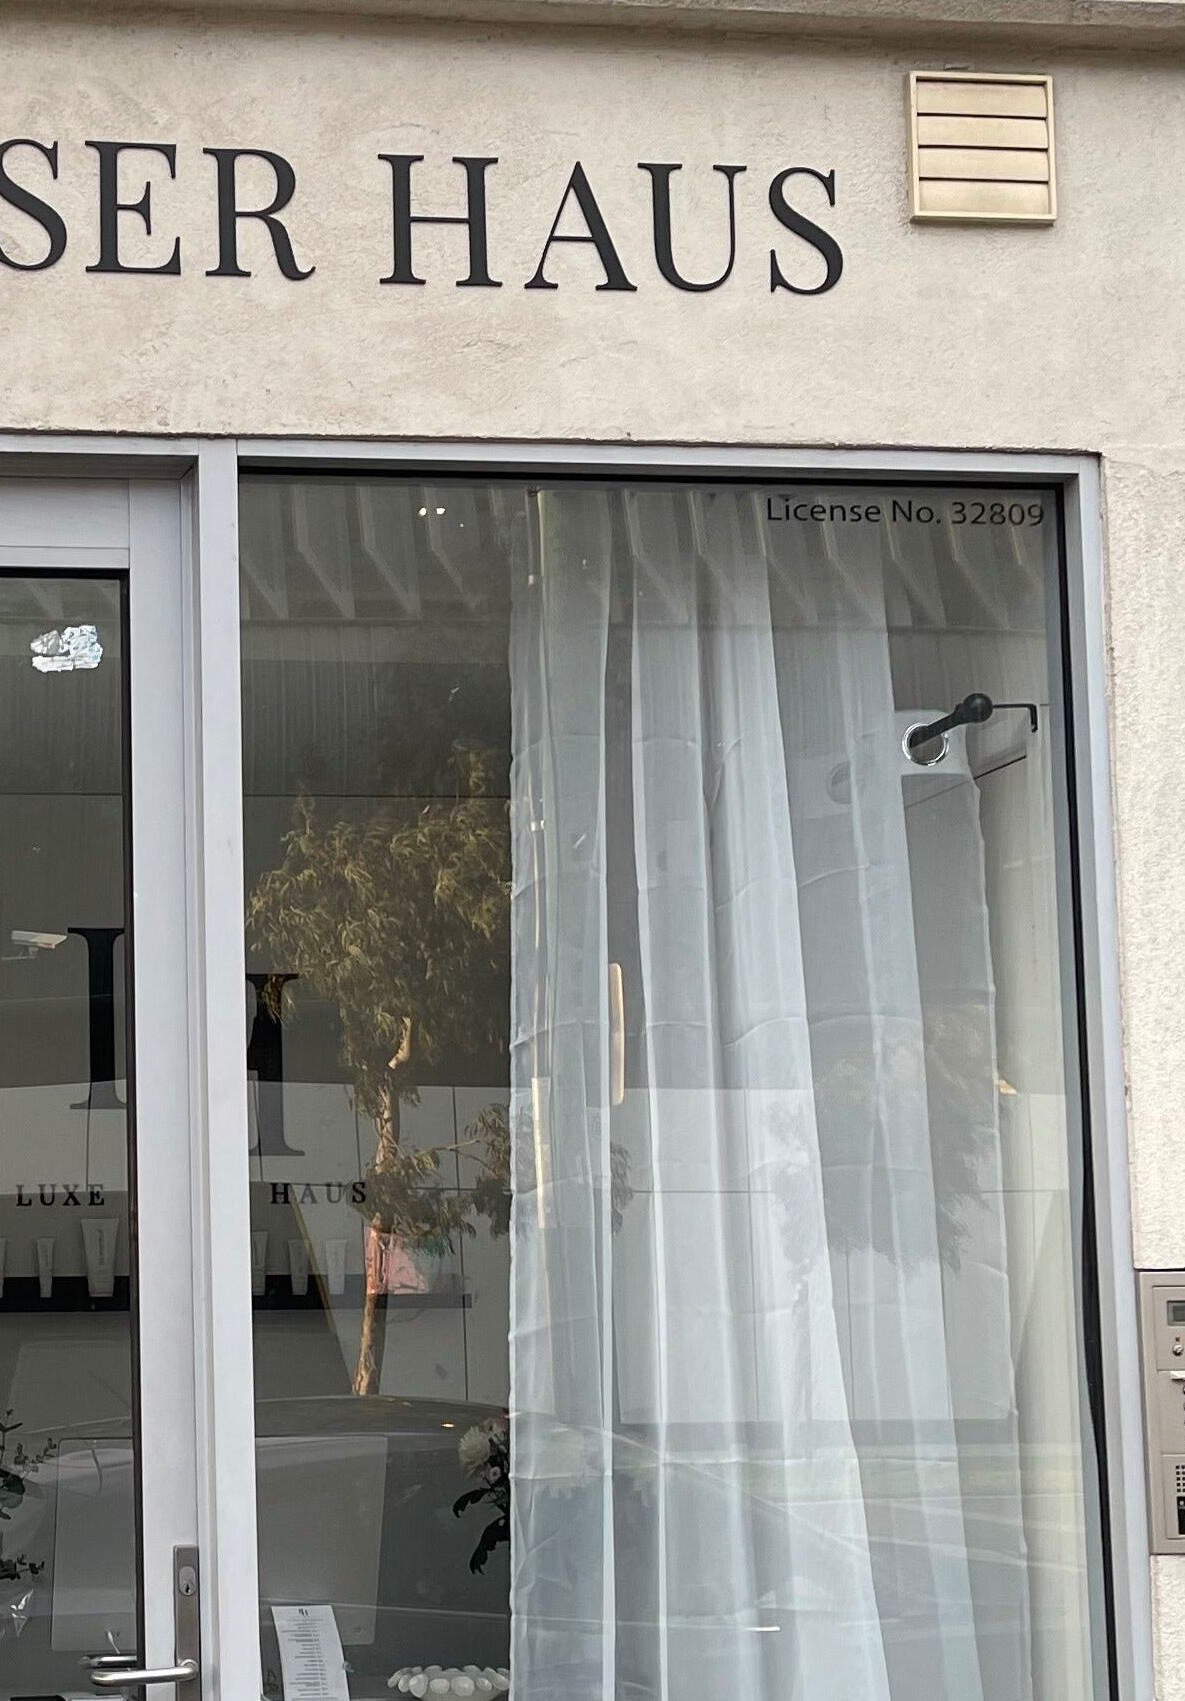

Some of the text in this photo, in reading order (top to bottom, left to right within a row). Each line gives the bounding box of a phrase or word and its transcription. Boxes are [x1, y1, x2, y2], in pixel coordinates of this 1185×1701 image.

[377, 153, 844, 296] HAUS
[766, 496, 1045, 527] License No. 32809
[15, 1181, 366, 1207] LUXE HAUS
